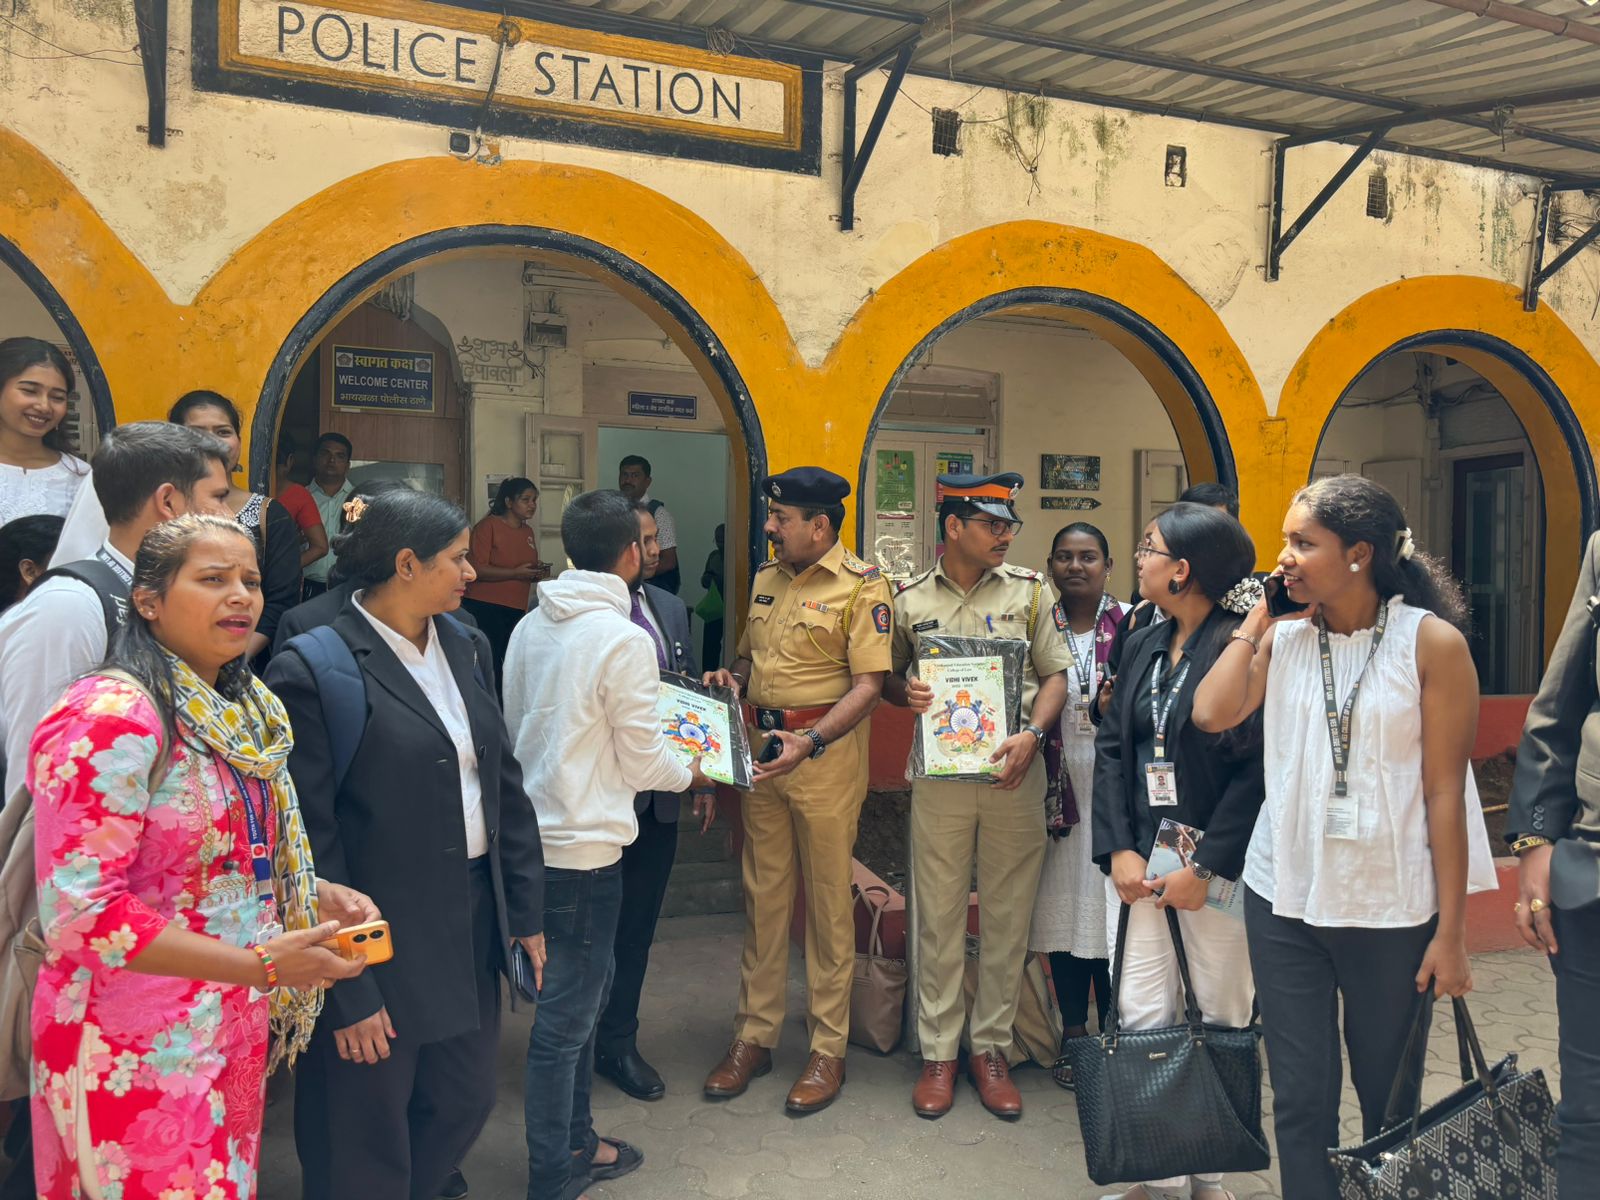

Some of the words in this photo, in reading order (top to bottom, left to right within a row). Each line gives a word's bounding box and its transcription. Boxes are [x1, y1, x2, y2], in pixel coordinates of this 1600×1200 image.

[277, 5, 478, 84] POLICE
[534, 50, 742, 121] STATION
[354, 356, 388, 369] स्वागत
[390, 358, 414, 370] कक्ष
[339, 375, 388, 387] WELCOME
[390, 378, 428, 390] CENTER
[380, 393, 408, 404] पोलीस
[410, 395, 426, 405] ठाणे
[1322, 667, 1333, 685] COLLEGE
[1330, 727, 1340, 747] COLLEGE
